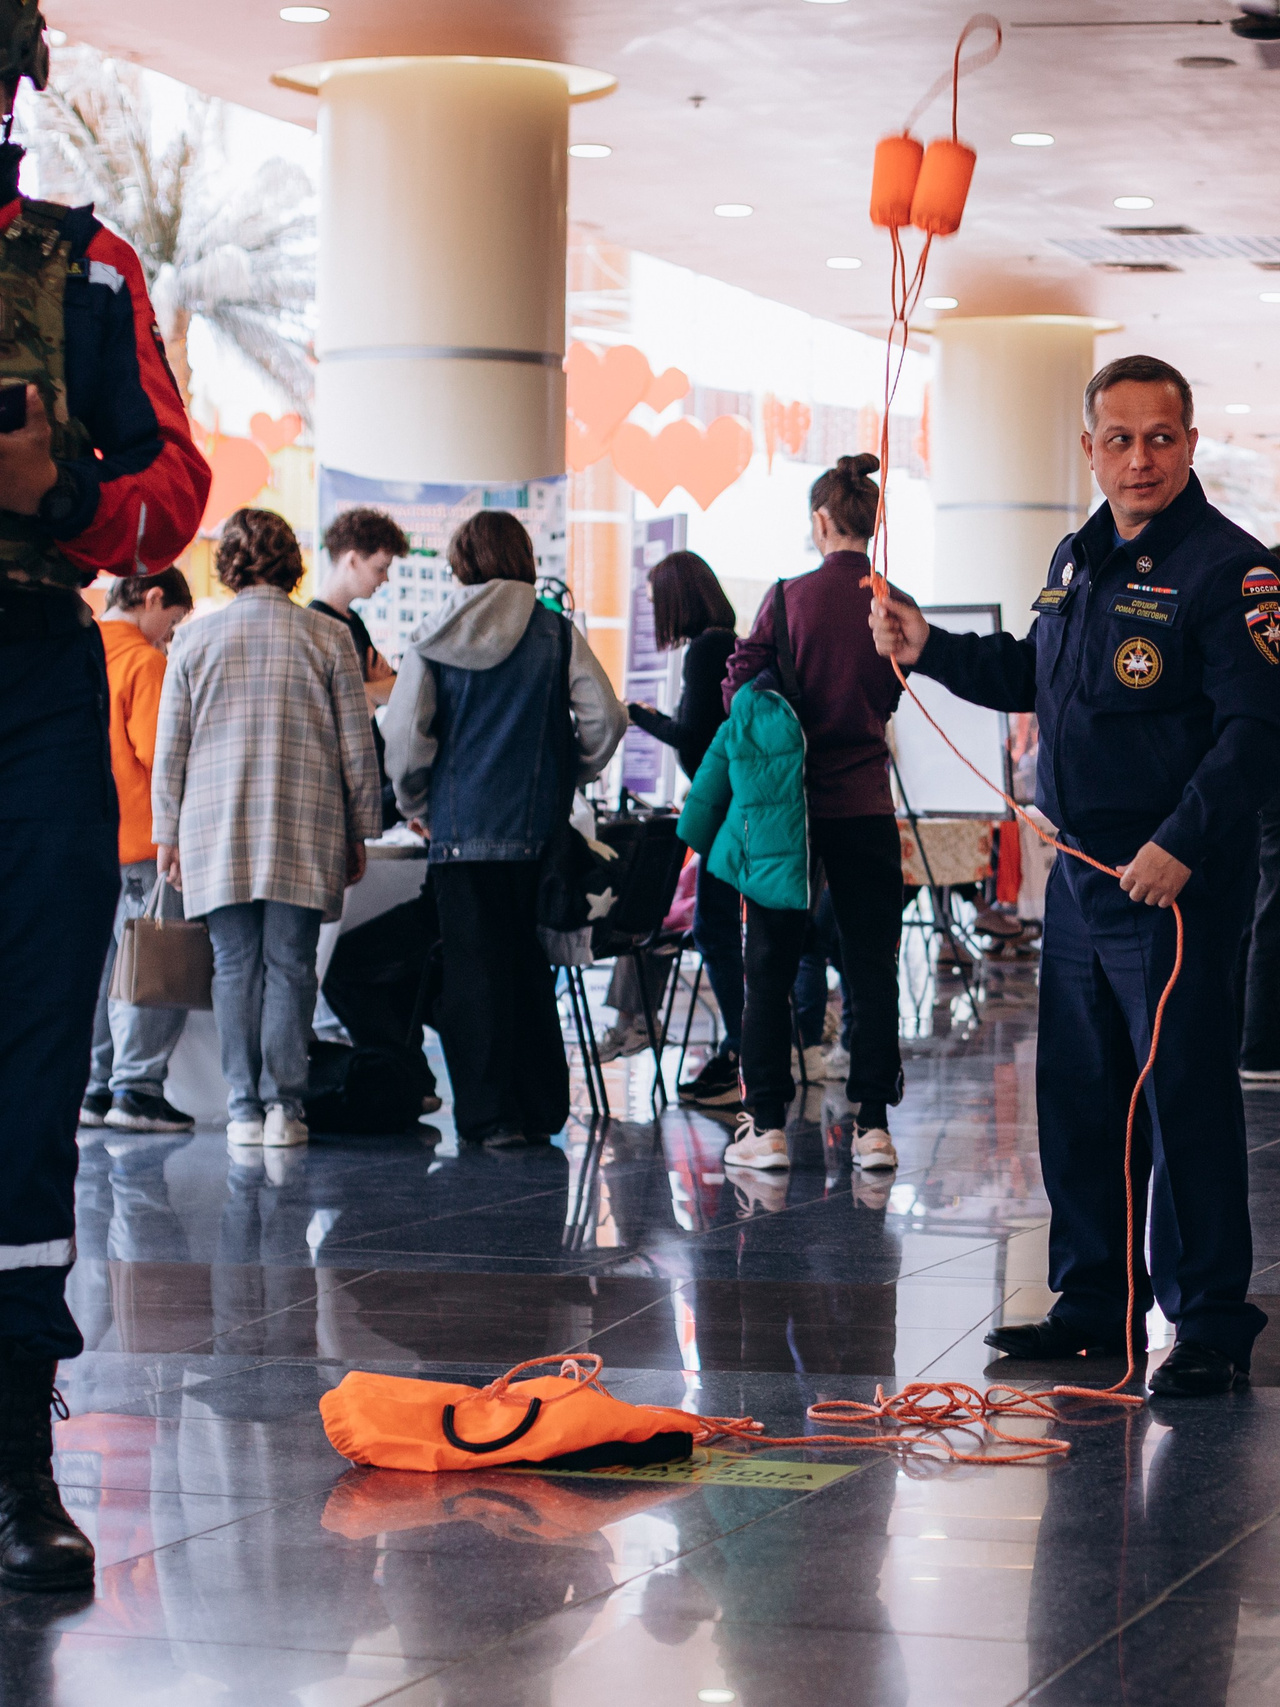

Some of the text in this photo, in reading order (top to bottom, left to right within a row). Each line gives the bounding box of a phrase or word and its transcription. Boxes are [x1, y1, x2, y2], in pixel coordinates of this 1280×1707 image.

[1250, 585, 1278, 593] РОССИЯ
[1131, 599, 1159, 610] СЛУЦКИЙ
[1114, 604, 1169, 622] РОМАН ОЛЕГОВИЧ
